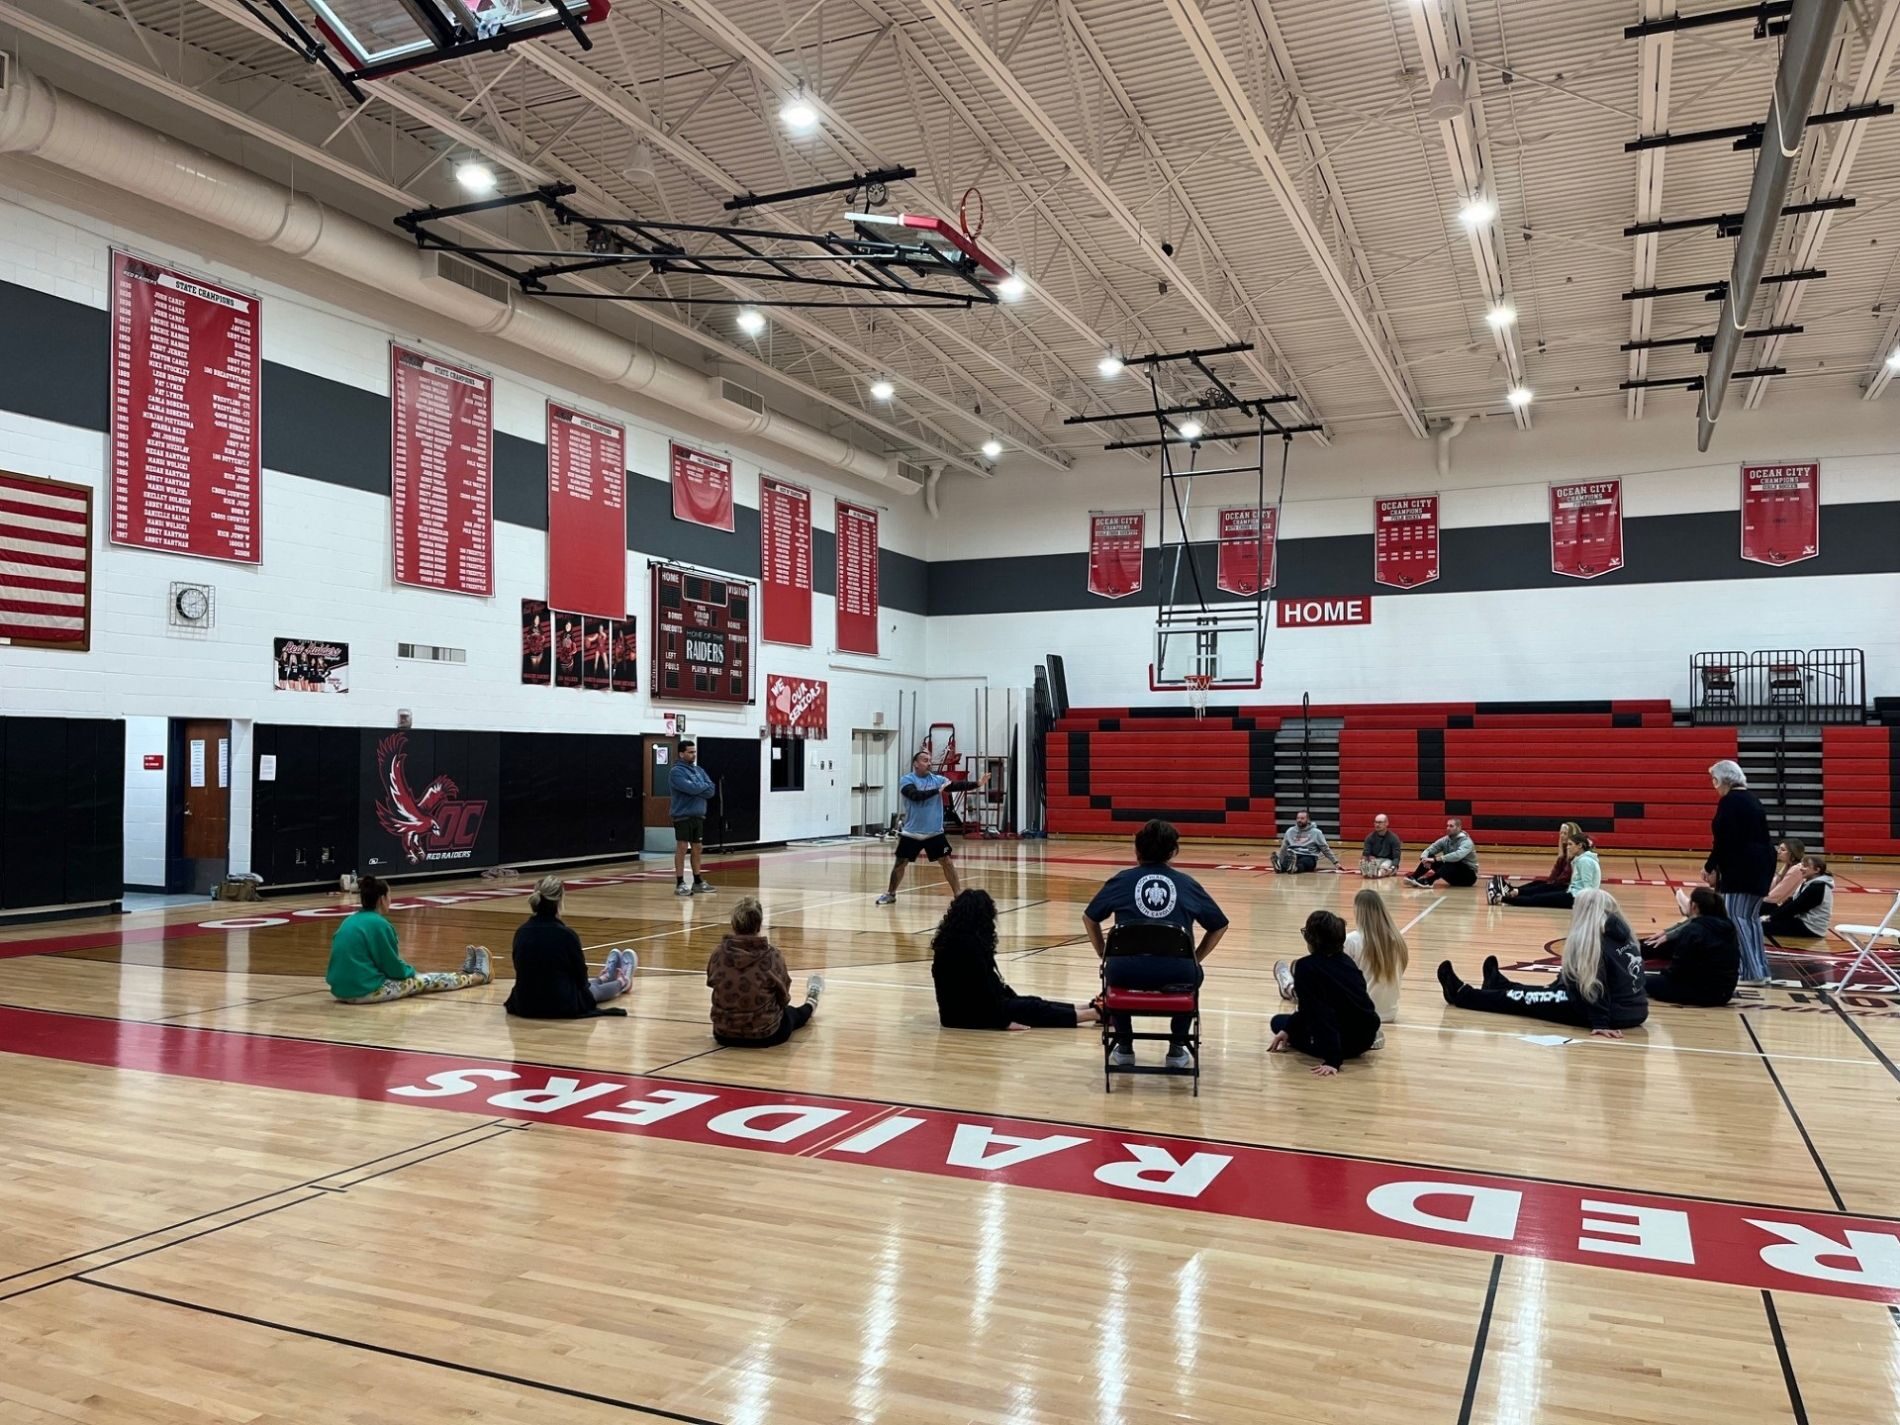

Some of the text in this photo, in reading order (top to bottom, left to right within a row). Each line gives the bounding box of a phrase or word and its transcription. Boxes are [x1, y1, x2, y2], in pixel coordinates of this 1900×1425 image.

[175, 281, 234, 306] STATE CHAMPIONS
[1749, 467, 1810, 479] OCEAN CITY
[1760, 476, 1799, 484] CHAMPIONS
[1557, 484, 1613, 498] OCEAN CITY
[1567, 493, 1603, 502] CHAMPIONS
[1381, 499, 1432, 511] OCEAN CITY
[1225, 511, 1250, 521] OCEAN
[1095, 517, 1139, 527] OCEAN CITY
[661, 572, 679, 583] HOME
[728, 586, 748, 597] VISITOR
[667, 611, 683, 620] BONUS
[1284, 600, 1363, 623] HOME
[660, 623, 682, 633] TIMEOUTS
[687, 630, 702, 639] HOME
[728, 633, 748, 643] TIMEOUTS
[665, 651, 677, 660] LEFT
[686, 639, 725, 663] RAIDERS
[665, 662, 680, 670] FOULS
[733, 659, 742, 667] LEFT
[692, 665, 722, 675] PLAYER FOULS
[730, 669, 742, 677] FOULS
[770, 678, 785, 697] WE
[791, 682, 808, 703] OUR
[788, 681, 821, 726] SENIORS
[426, 850, 472, 860] RED RAIDERS
[1136, 898, 1150, 917] SOUTH
[387, 1066, 1900, 1289] RED RAIDERS
